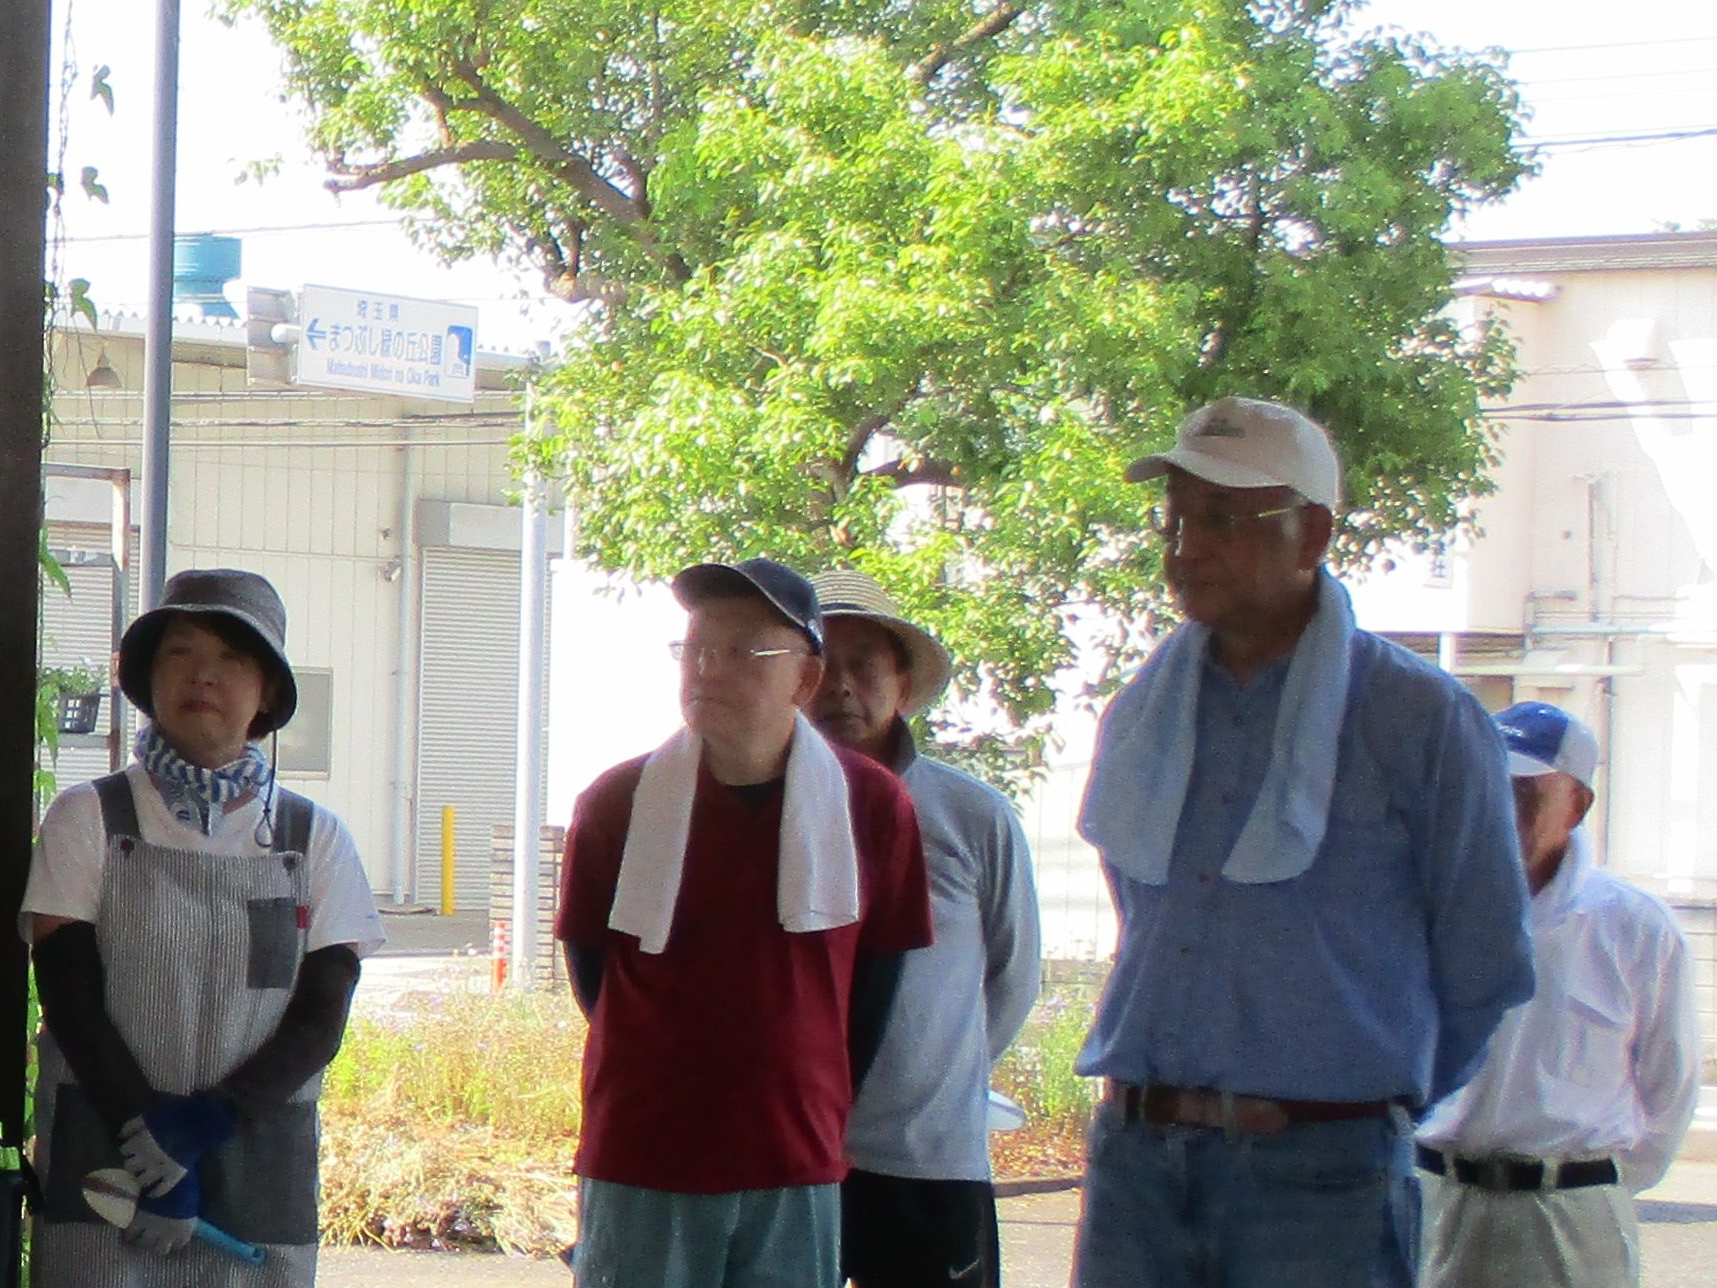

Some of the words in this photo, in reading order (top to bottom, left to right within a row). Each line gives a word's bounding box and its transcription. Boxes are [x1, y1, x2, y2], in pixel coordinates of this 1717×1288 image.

[357, 300, 399, 322] 埼玉県
[328, 323, 443, 365] まつぶし緑の丘公園
